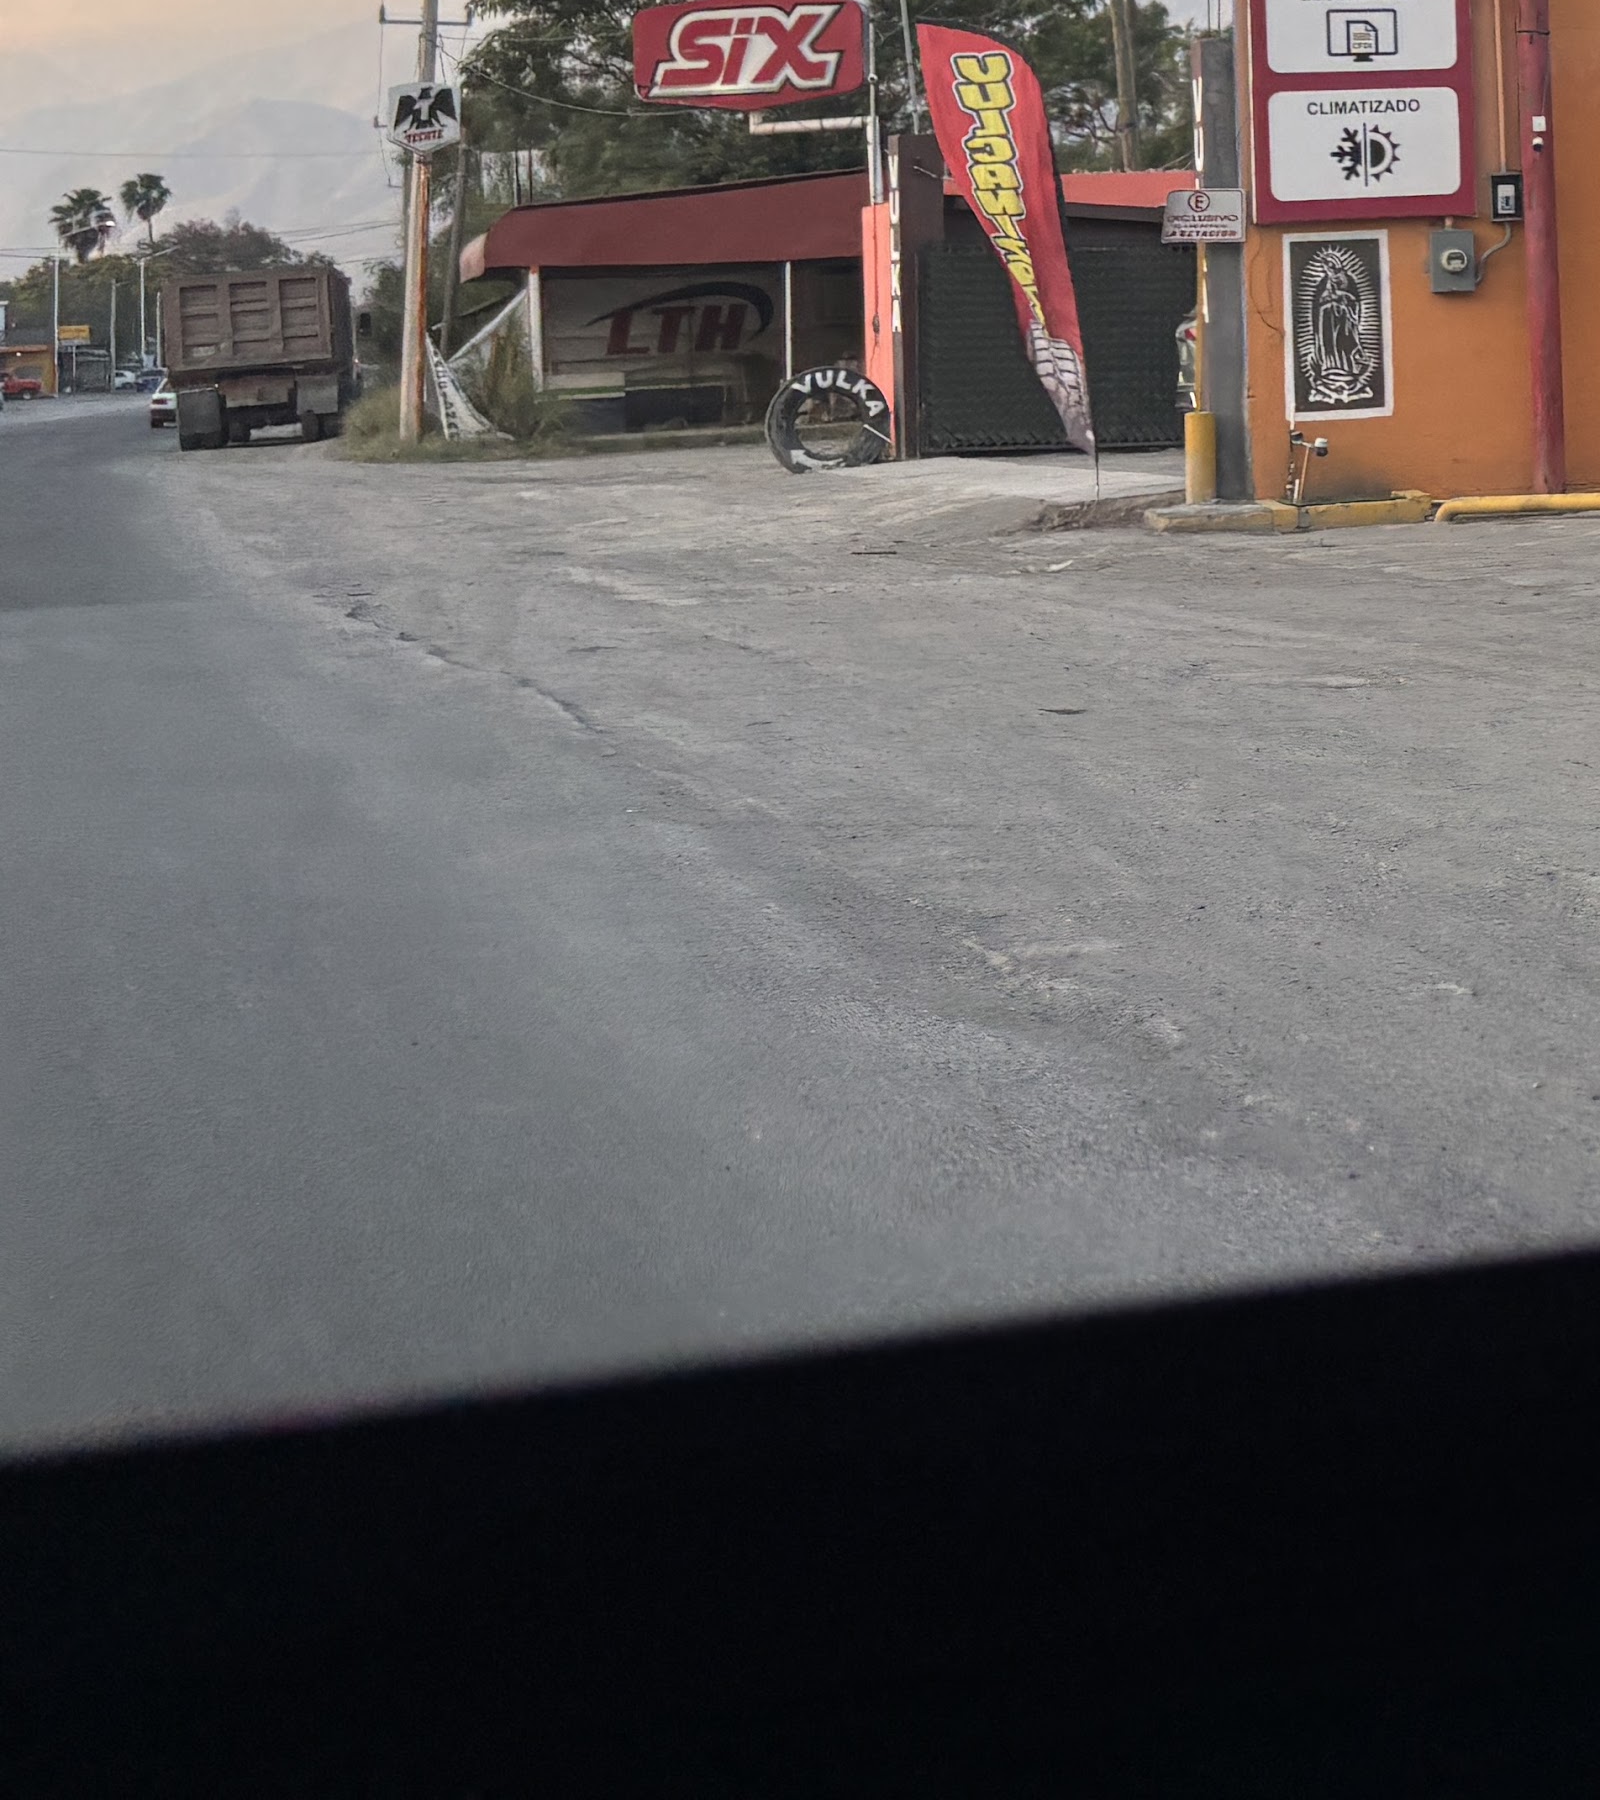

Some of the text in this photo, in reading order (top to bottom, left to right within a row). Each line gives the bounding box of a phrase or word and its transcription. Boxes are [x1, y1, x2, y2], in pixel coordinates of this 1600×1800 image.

[1307, 99, 1421, 115] CLIMATIZADO
[605, 304, 748, 357] LTH
[791, 369, 885, 417] VULKA
